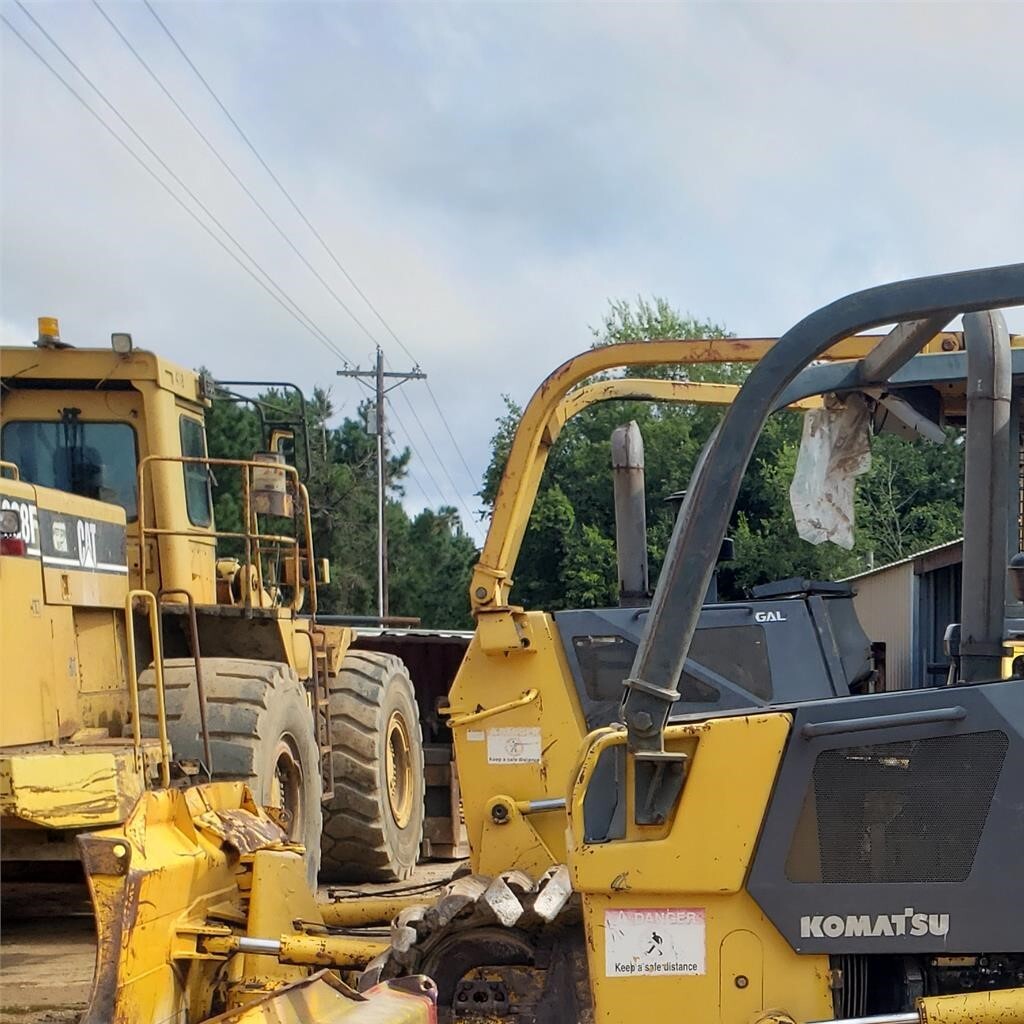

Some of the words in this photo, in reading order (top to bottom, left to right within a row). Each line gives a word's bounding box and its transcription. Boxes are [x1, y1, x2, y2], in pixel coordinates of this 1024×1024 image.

[2, 499, 39, 544] 8F
[77, 519, 97, 568] CAT
[755, 611, 787, 622] GAL
[800, 907, 950, 938] KOMATSU
[615, 962, 636, 973] Keep
[637, 963, 643, 972] a
[663, 961, 699, 971] distance
